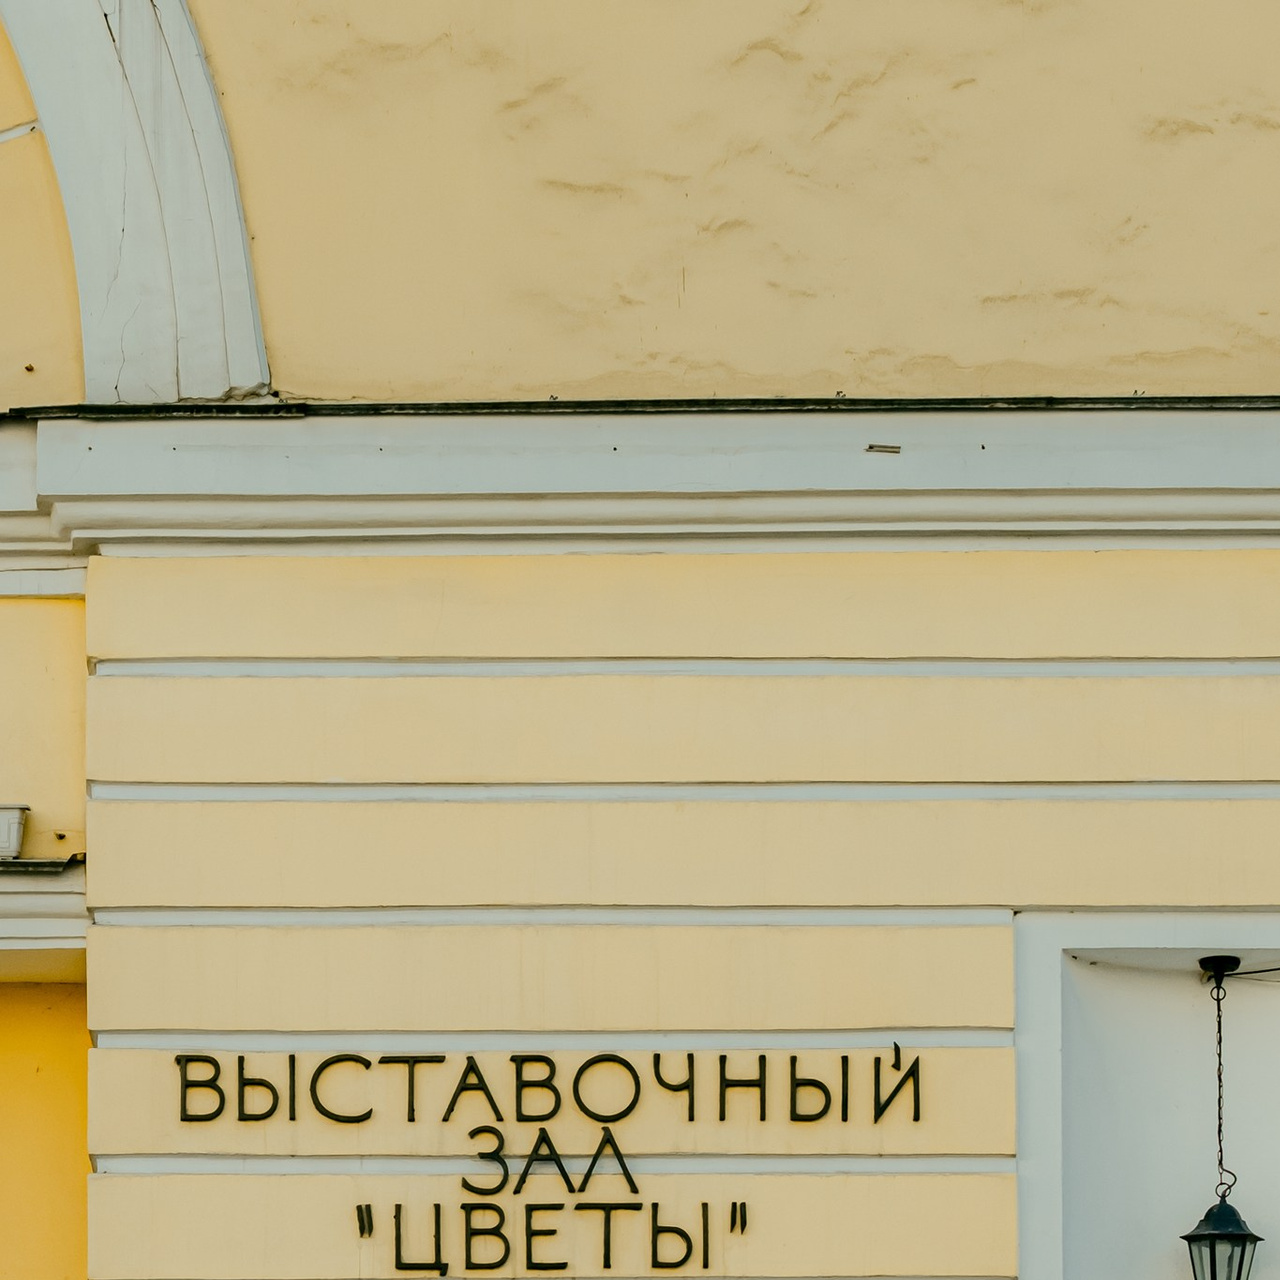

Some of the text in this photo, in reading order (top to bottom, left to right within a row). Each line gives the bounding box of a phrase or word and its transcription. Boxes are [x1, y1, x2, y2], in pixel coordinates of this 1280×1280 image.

[175, 1041, 922, 1124] ВЫСТАВОЧНЫЙ
[461, 1125, 639, 1195] ЗАЛ
[356, 1200, 748, 1276] "ЦВЕТЫ"
